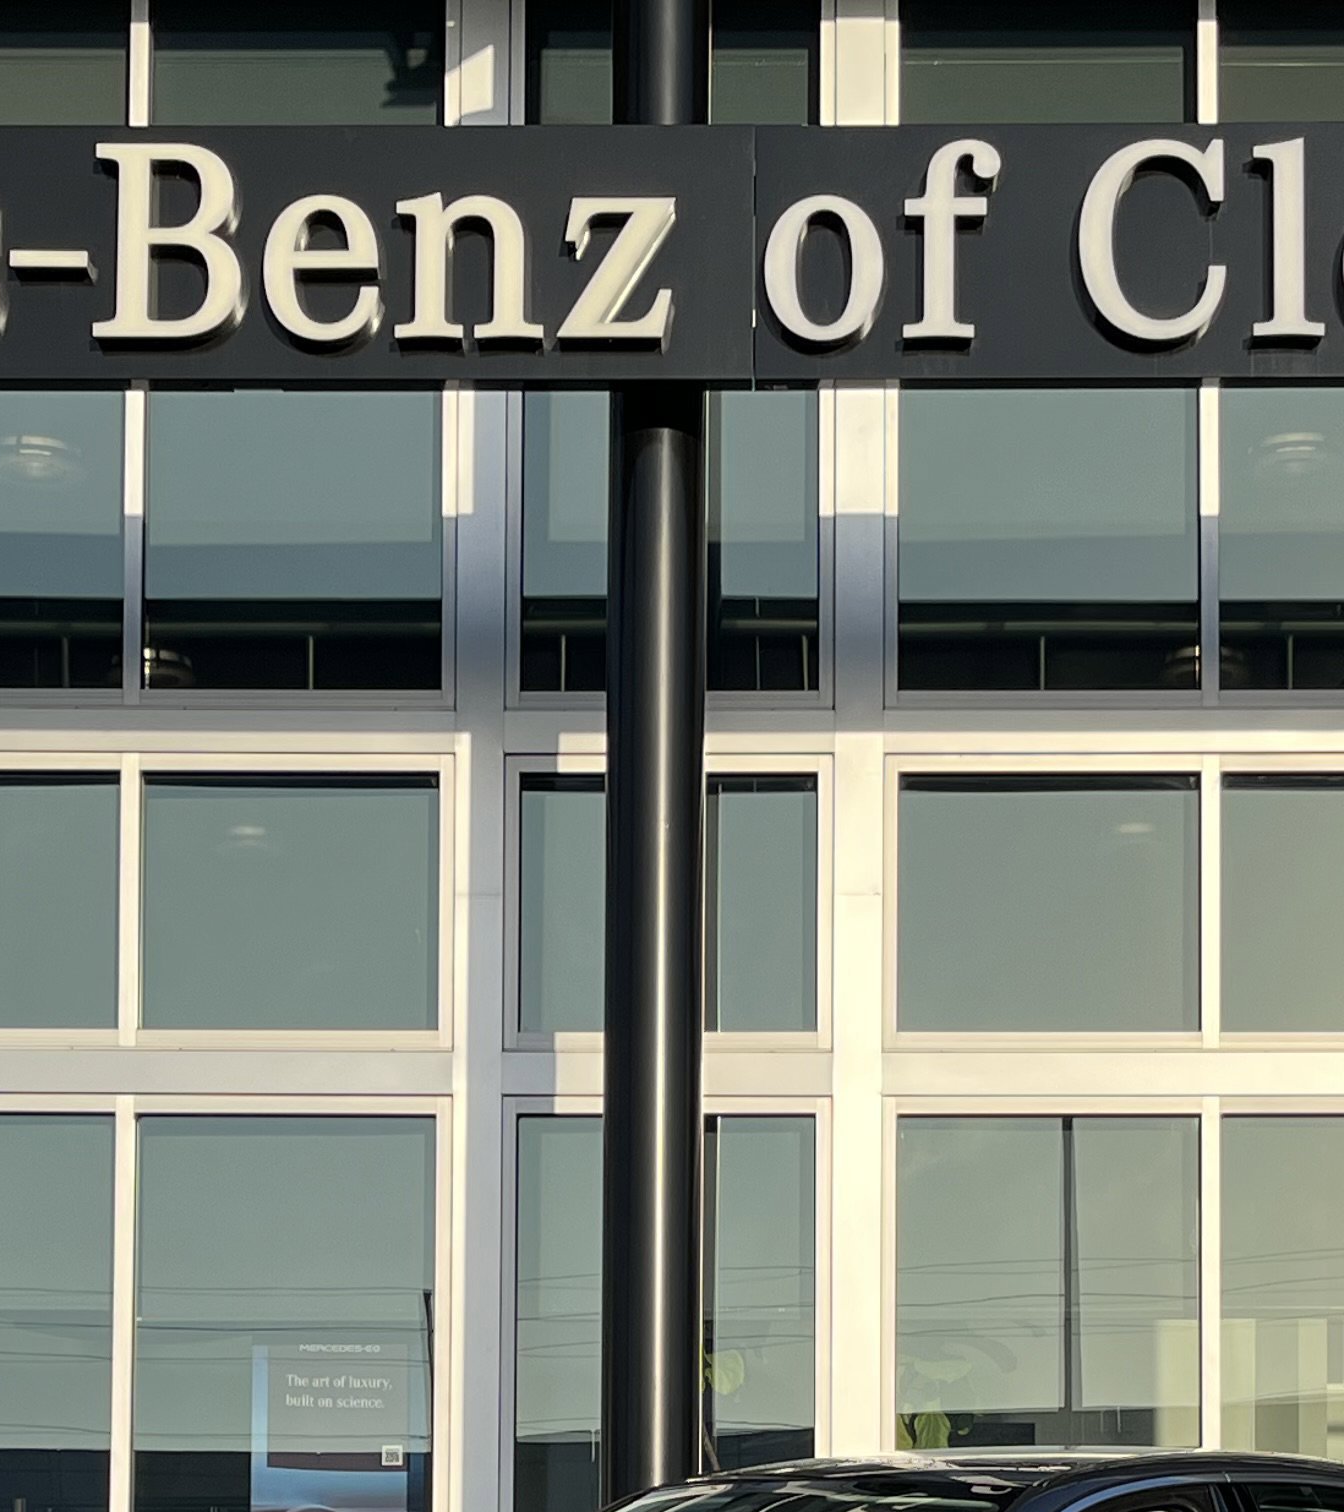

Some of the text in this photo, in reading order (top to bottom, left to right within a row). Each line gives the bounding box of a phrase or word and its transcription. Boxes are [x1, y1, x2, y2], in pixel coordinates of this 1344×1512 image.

[763, 138, 1002, 344] of
[286, 1374, 393, 1392] The art of luxury,
[286, 1393, 385, 1409] built on science.
